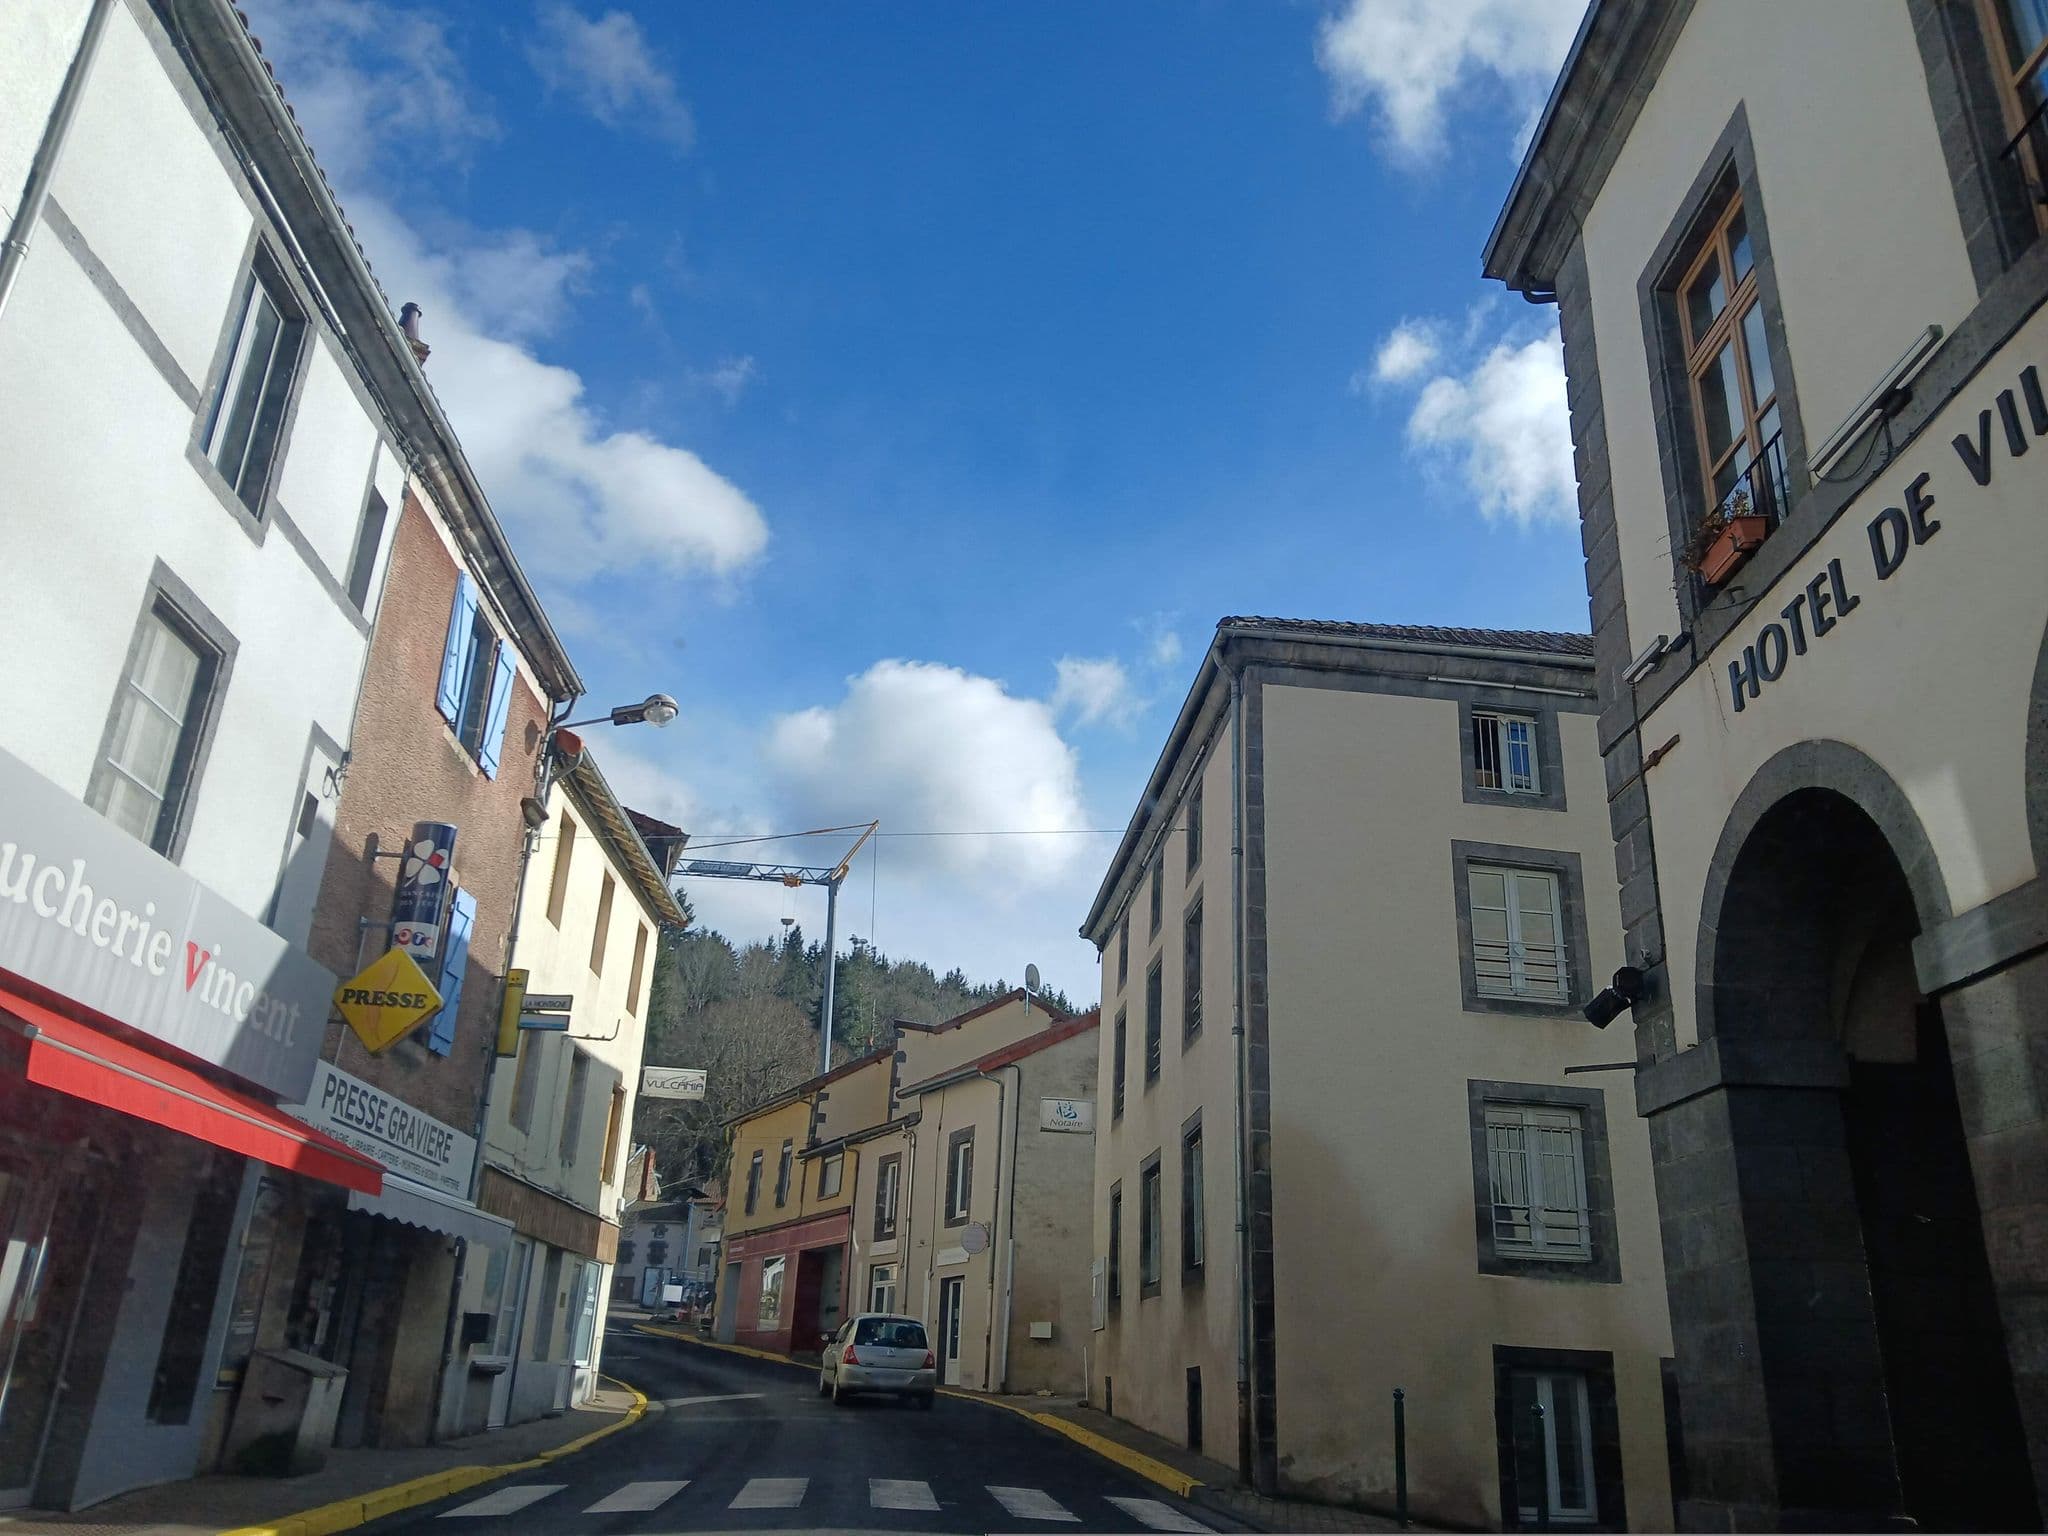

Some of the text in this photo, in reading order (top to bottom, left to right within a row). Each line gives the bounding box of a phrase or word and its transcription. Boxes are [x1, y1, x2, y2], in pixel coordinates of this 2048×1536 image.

[1728, 558, 1860, 712] HOTEL
[1866, 472, 1942, 581] DE
[185, 940, 300, 1048] vincent
[342, 988, 428, 1009] PRESSE
[646, 1079, 704, 1091] VULCANIA
[321, 1072, 454, 1164] PRESSE GRAVIERE
[1050, 1119, 1084, 1128] Notaire
